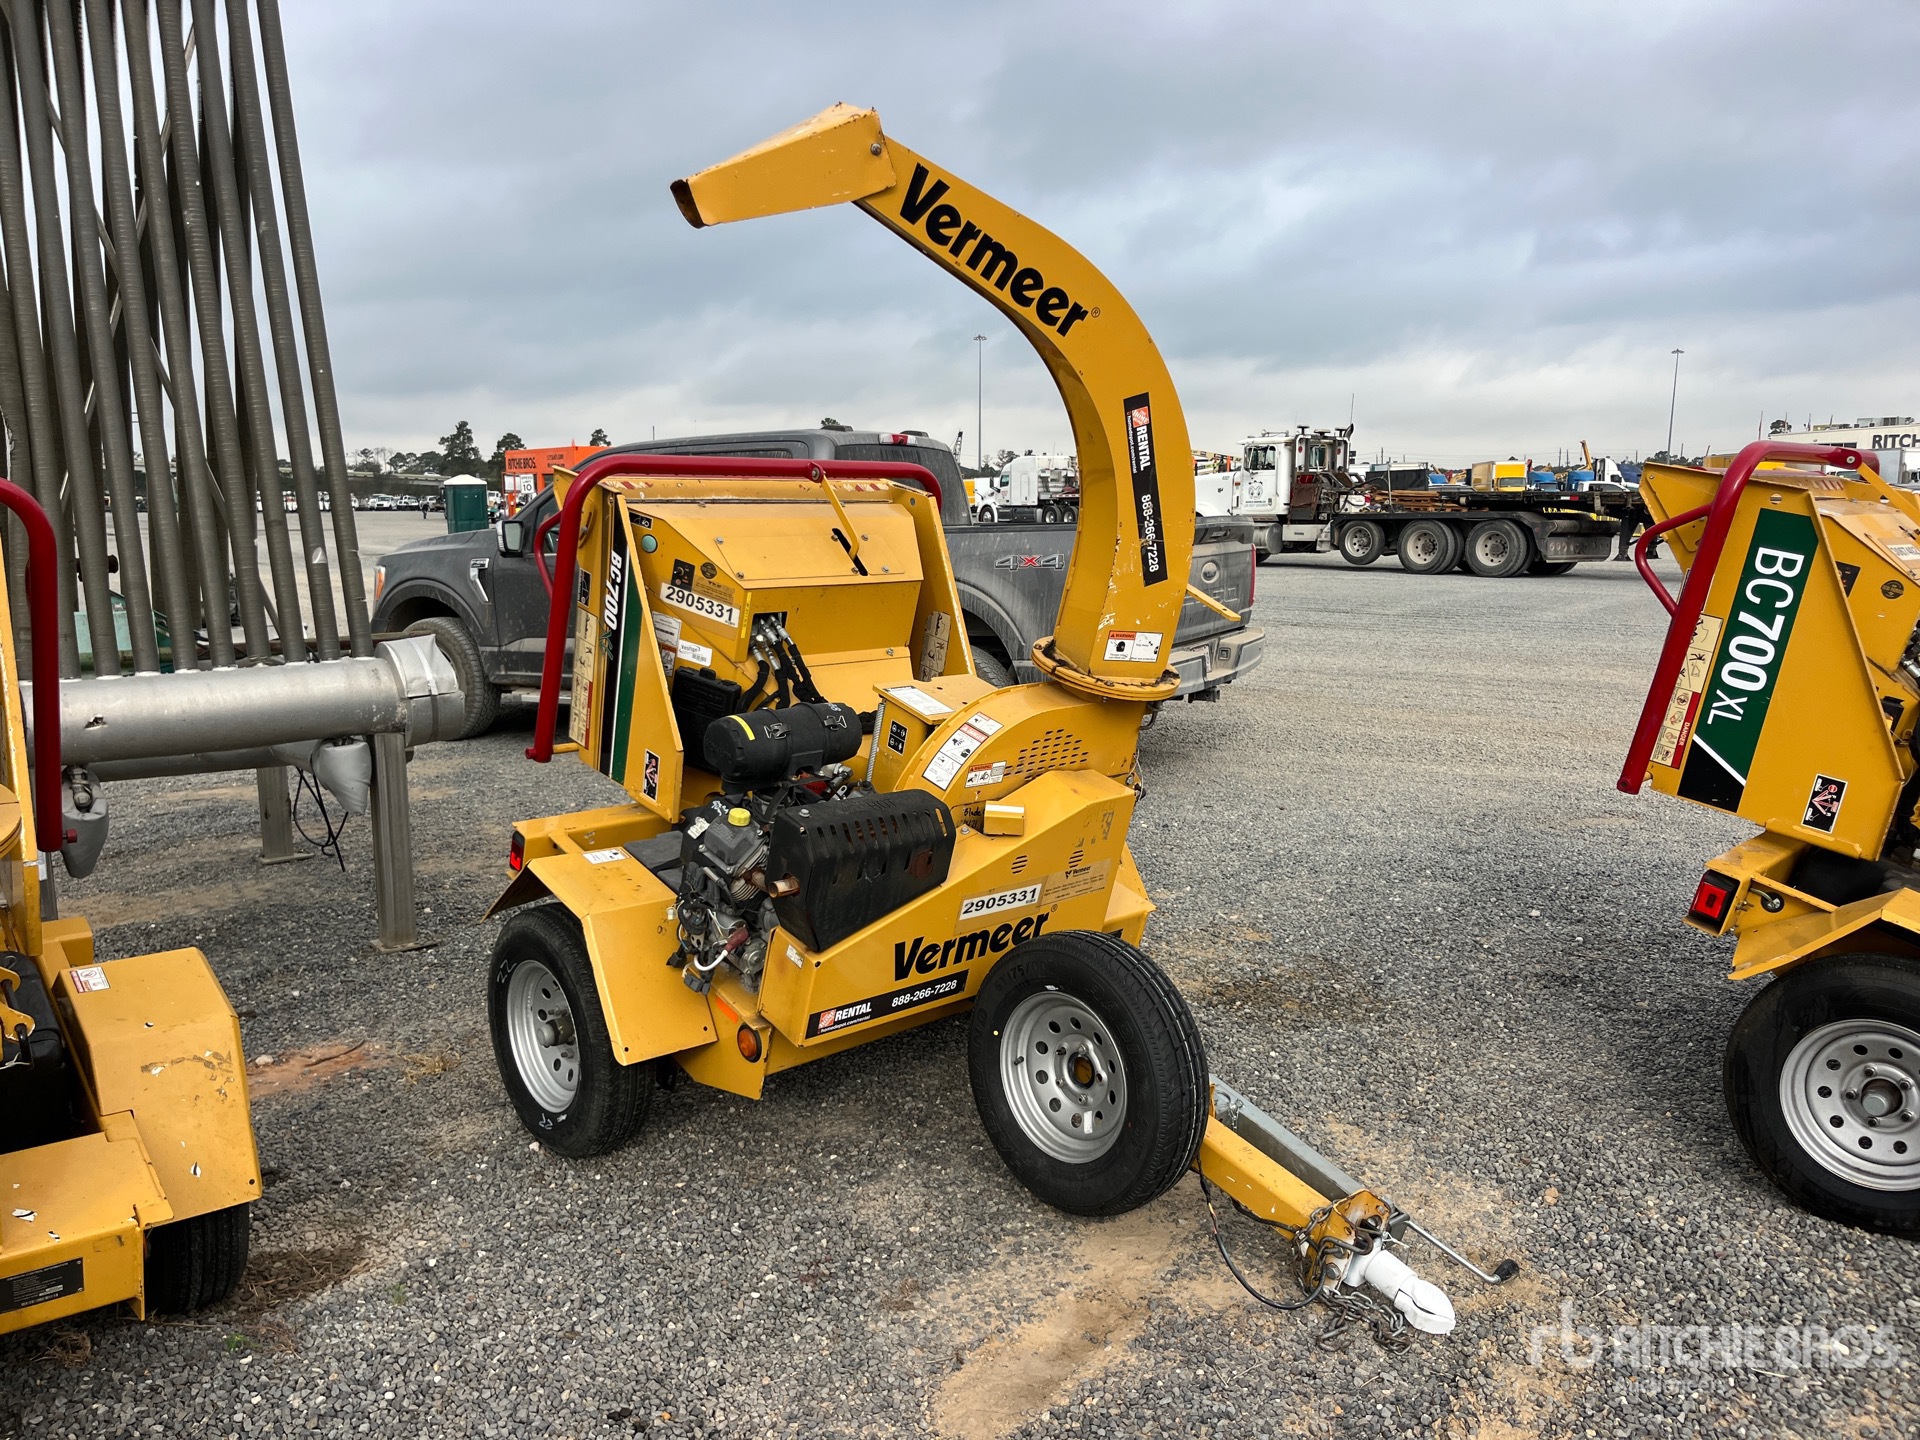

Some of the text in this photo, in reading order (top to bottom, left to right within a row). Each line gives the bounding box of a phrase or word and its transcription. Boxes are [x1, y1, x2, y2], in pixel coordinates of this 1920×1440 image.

[899, 161, 1089, 338] Vermeer
[1136, 425, 1151, 472] RENTAL
[508, 458, 523, 470] RITCHIE
[522, 484, 533, 492] 10
[1141, 493, 1160, 573] 888-266-7228
[604, 549, 623, 631] BC700
[665, 586, 734, 622] 2905331
[1678, 721, 1691, 747] DANGER
[962, 887, 1037, 915] 2905331
[894, 912, 1049, 982] Vermeer
[891, 979, 958, 1008] 888-266-7228
[820, 1014, 871, 1034] homedepot.com/rental
[834, 1001, 872, 1022] RENTAL
